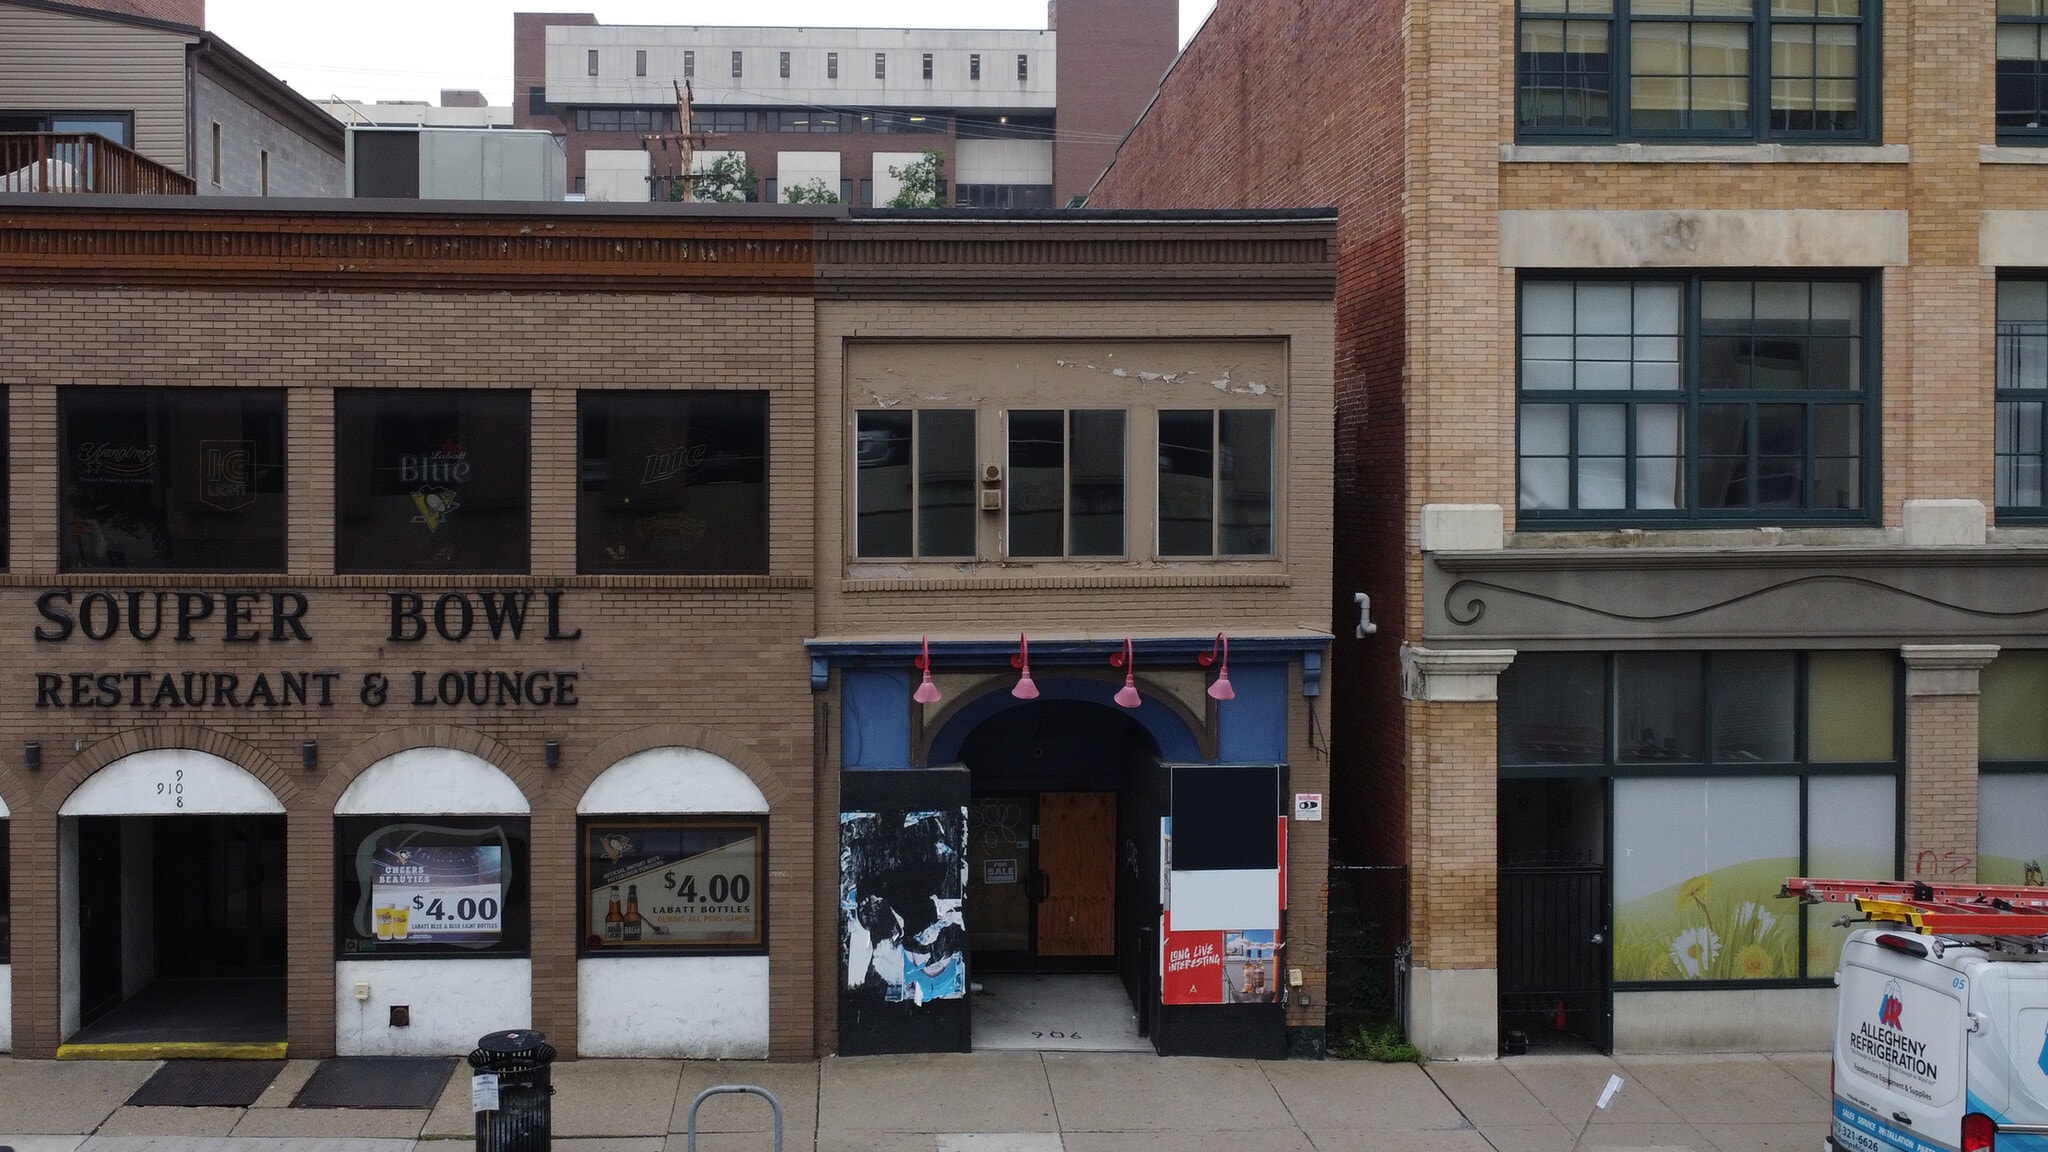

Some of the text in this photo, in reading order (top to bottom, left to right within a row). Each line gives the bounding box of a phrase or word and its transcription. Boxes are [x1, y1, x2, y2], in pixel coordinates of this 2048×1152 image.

[80, 441, 157, 463] Yuengling
[400, 455, 470, 482] Blue
[208, 484, 249, 497] LIGHT
[34, 588, 583, 642] SOUPER BOWL
[34, 669, 579, 707] RESTAURANT & LOUNGE
[379, 875, 431, 884] BEAUTIES
[385, 866, 425, 874] CHEERS
[987, 867, 1015, 876] SALE
[664, 870, 751, 904] $4.00
[413, 894, 499, 921] $4.00
[652, 905, 751, 914] LABATT BOTTLES
[657, 915, 685, 923] DURING
[688, 914, 702, 923] ALL
[725, 914, 750, 922] GAMES
[1170, 947, 1191, 963] LONG
[1952, 977, 1966, 990] 05
[1859, 1021, 1927, 1058] ALLEGHENY
[1850, 1032, 1938, 1080] REFRIGERATION
[1842, 1108, 1856, 1121] SALES
[1856, 1115, 1877, 1131] SERVICE
[1877, 1126, 1915, 1149] INSTALLATION
